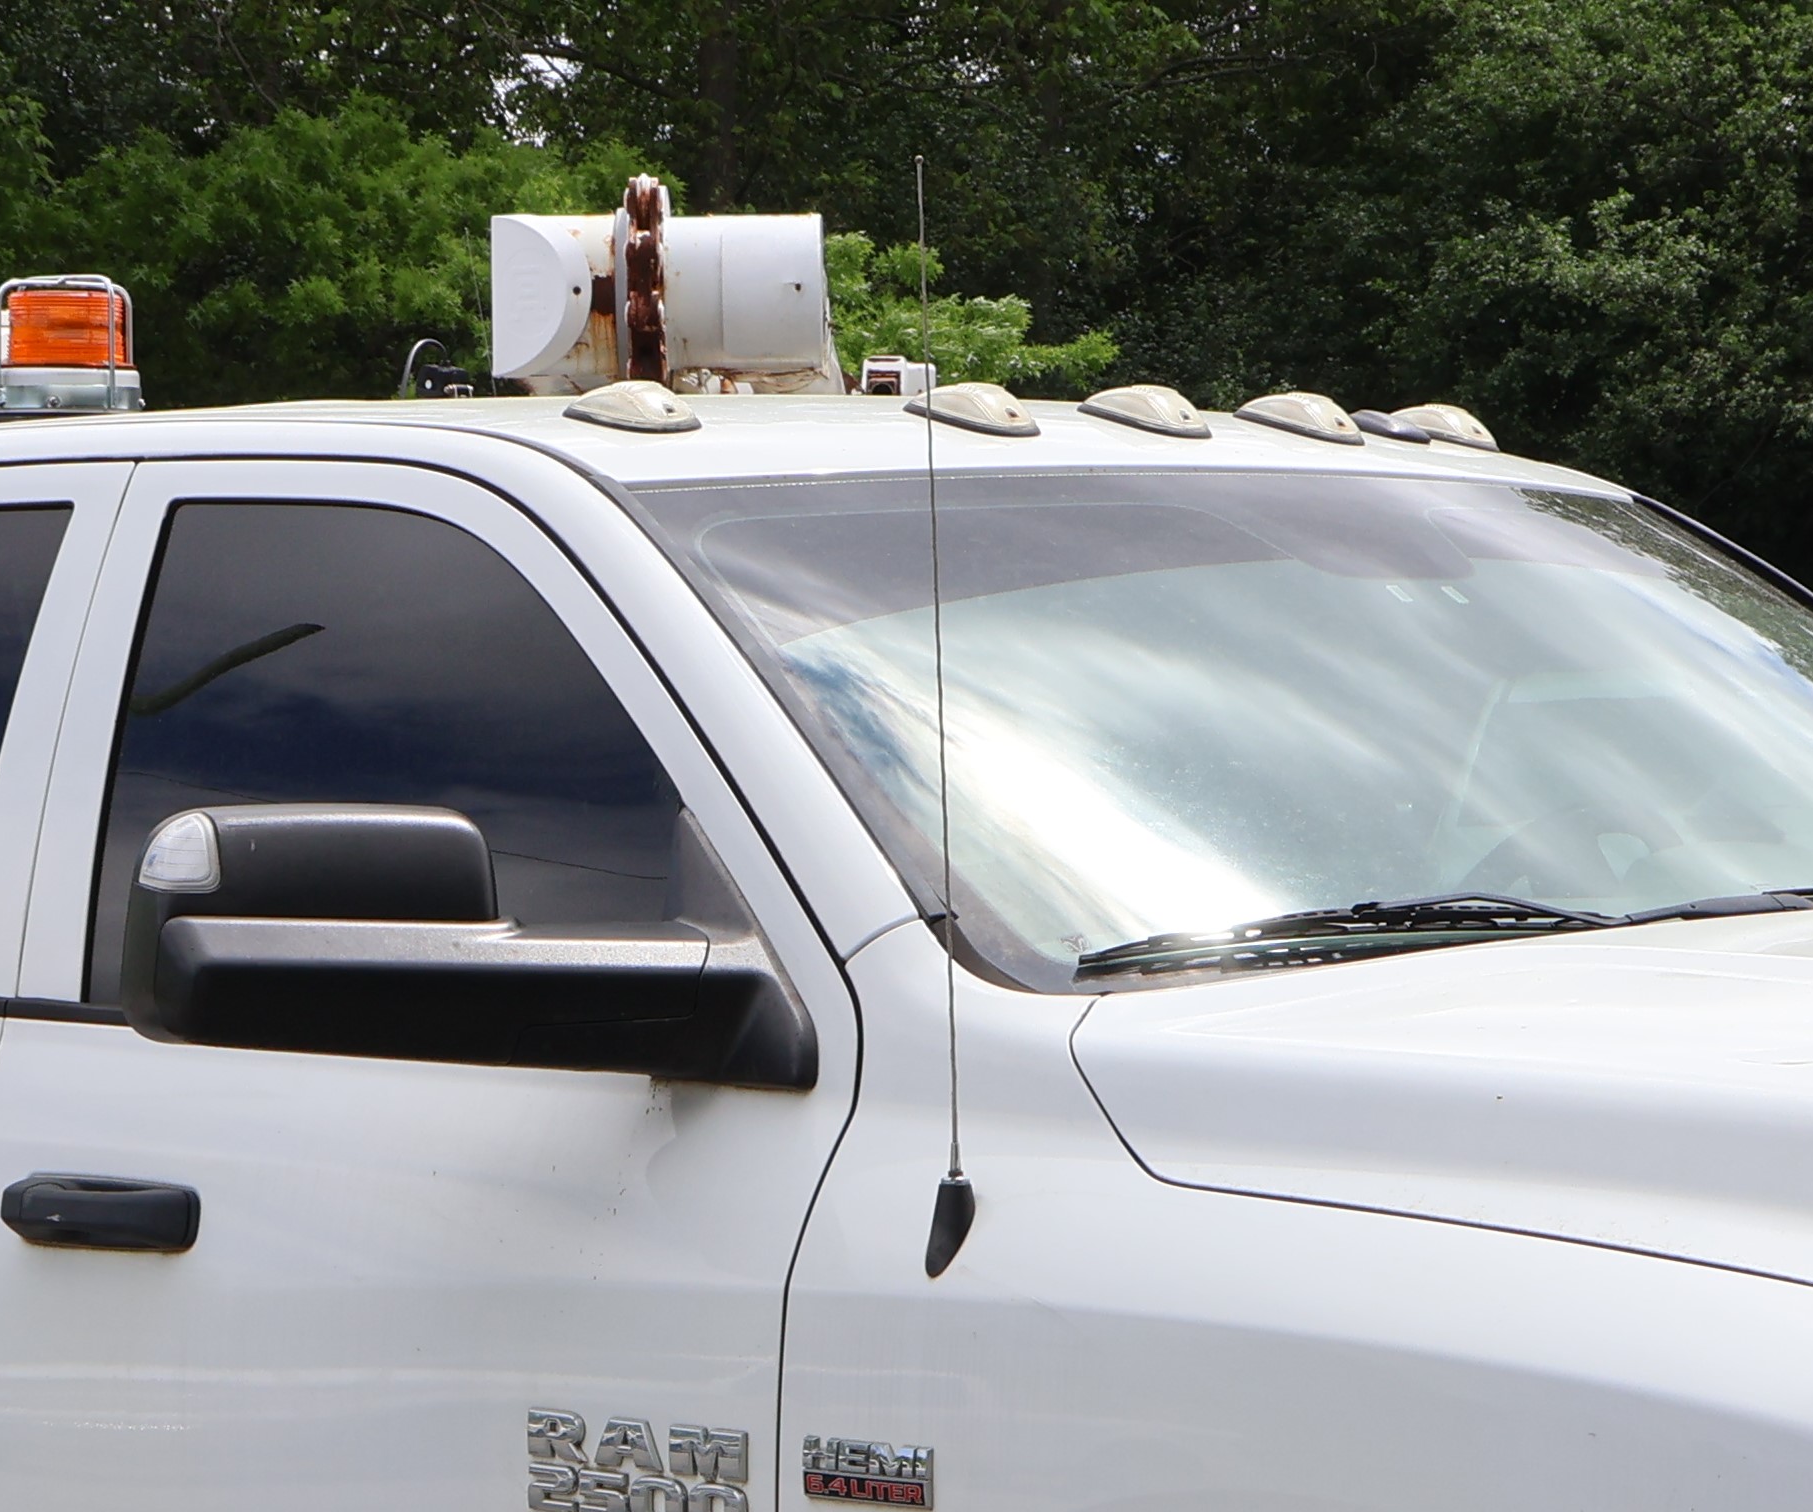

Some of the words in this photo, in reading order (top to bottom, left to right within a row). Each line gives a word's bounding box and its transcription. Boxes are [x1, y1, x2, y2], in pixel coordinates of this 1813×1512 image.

[527, 1406, 748, 1484] RAM
[803, 1435, 934, 1480] HEMI
[806, 1473, 847, 1496] 6.4
[850, 1479, 924, 1504] LITER
